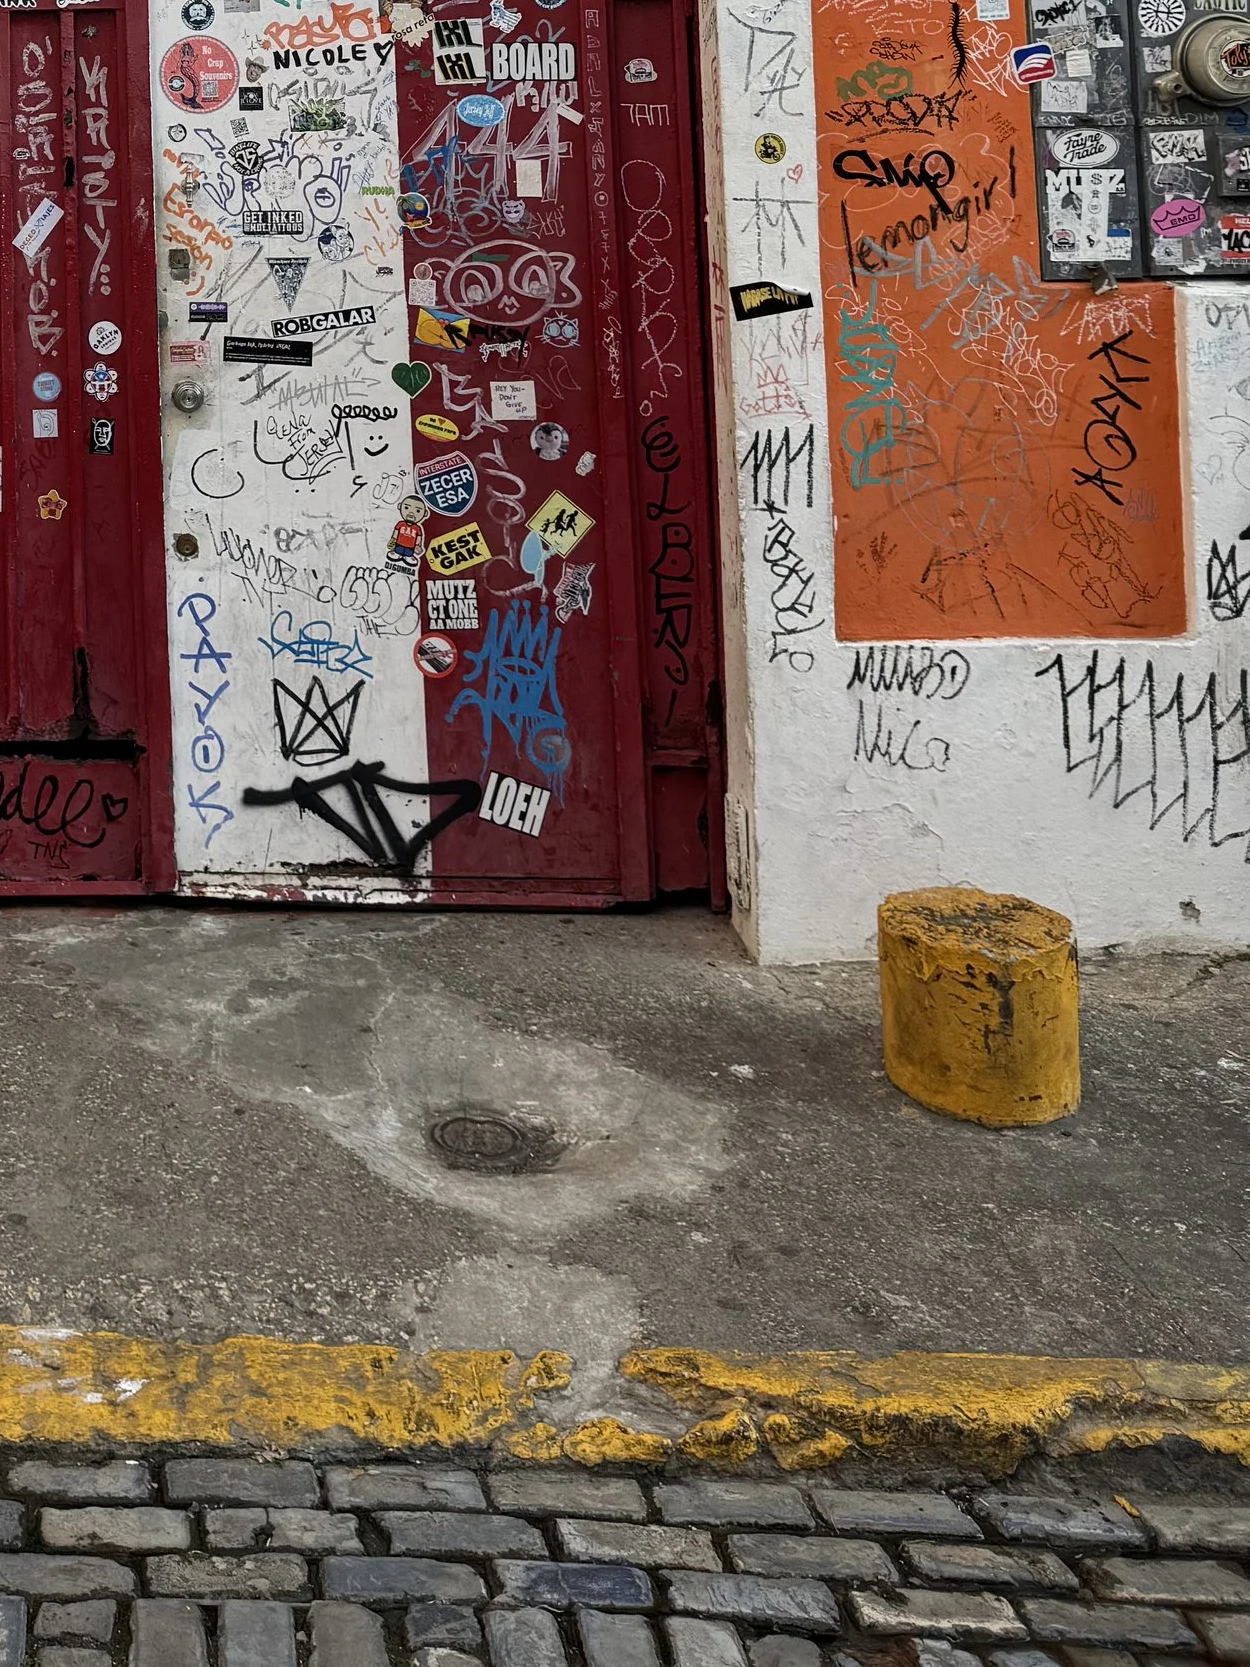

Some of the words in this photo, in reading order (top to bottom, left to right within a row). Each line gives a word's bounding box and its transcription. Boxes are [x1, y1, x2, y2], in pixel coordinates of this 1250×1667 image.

[202, 45, 212, 55] No
[273, 43, 367, 70] NICOLE
[492, 43, 576, 81] BOARD
[200, 70, 233, 81] Souvenirs
[1064, 132, 1102, 152] Fayre
[1064, 142, 1107, 162] Trade
[244, 211, 263, 223] GET
[267, 211, 303, 223] INKED
[418, 455, 463, 477] INTERSTATE
[420, 467, 474, 496] ZECER
[438, 488, 471, 509] ESA
[431, 529, 481, 559] KEST
[440, 544, 483, 570] GAK
[426, 579, 477, 600] MUTZ
[428, 599, 449, 620] CT
[450, 599, 479, 619] ONE
[429, 618, 444, 630] AA
[445, 618, 479, 629] MOBB
[479, 772, 550, 835] LOEH
